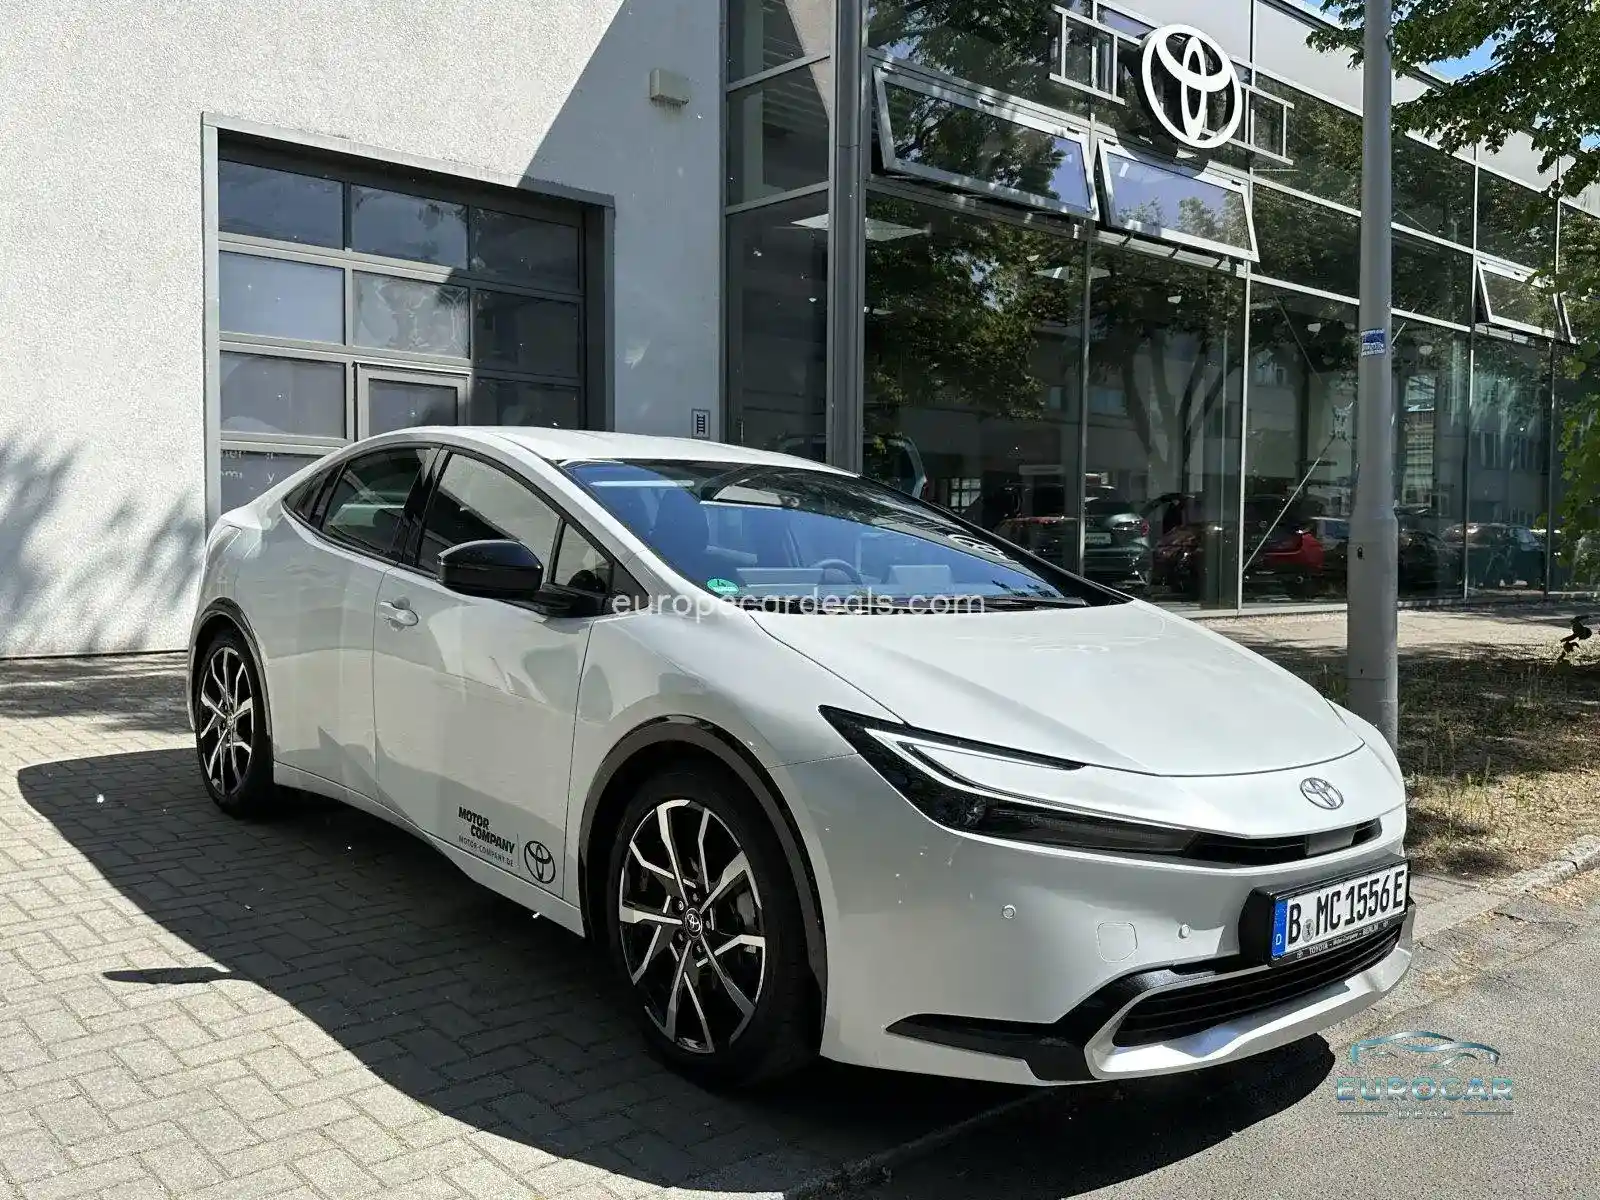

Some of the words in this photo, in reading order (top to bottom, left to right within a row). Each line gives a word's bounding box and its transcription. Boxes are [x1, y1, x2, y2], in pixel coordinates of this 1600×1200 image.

[458, 806, 490, 831] MOTOR
[470, 824, 515, 854] COMPANY
[1288, 903, 1301, 945] B
[1274, 933, 1282, 946] D
